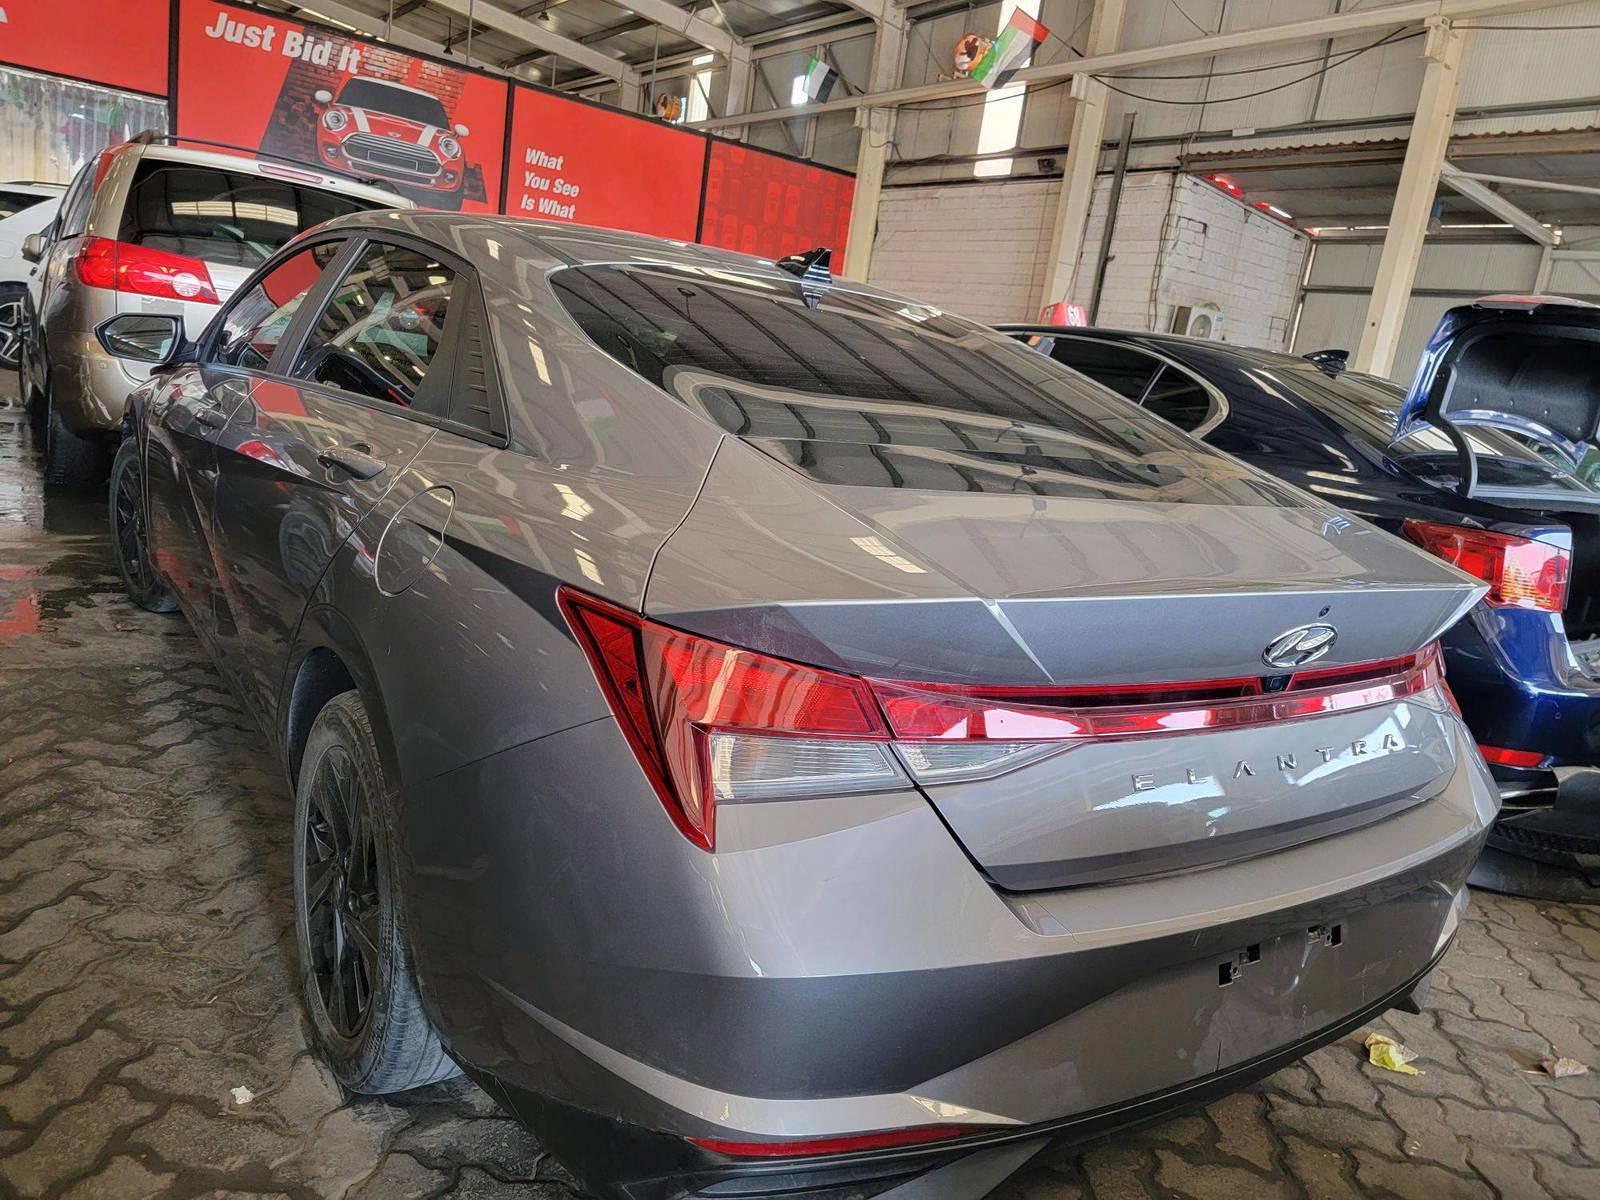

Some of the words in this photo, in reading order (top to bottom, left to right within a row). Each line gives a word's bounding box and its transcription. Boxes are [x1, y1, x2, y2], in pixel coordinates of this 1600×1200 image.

[205, 12, 276, 52] Just
[281, 30, 333, 67] Bid
[337, 46, 361, 74] It
[525, 147, 564, 171] What
[524, 171, 551, 191] You
[553, 178, 580, 198] See
[521, 194, 536, 211] Is
[538, 197, 576, 220] What
[1131, 733, 1400, 792] ELANTRA
